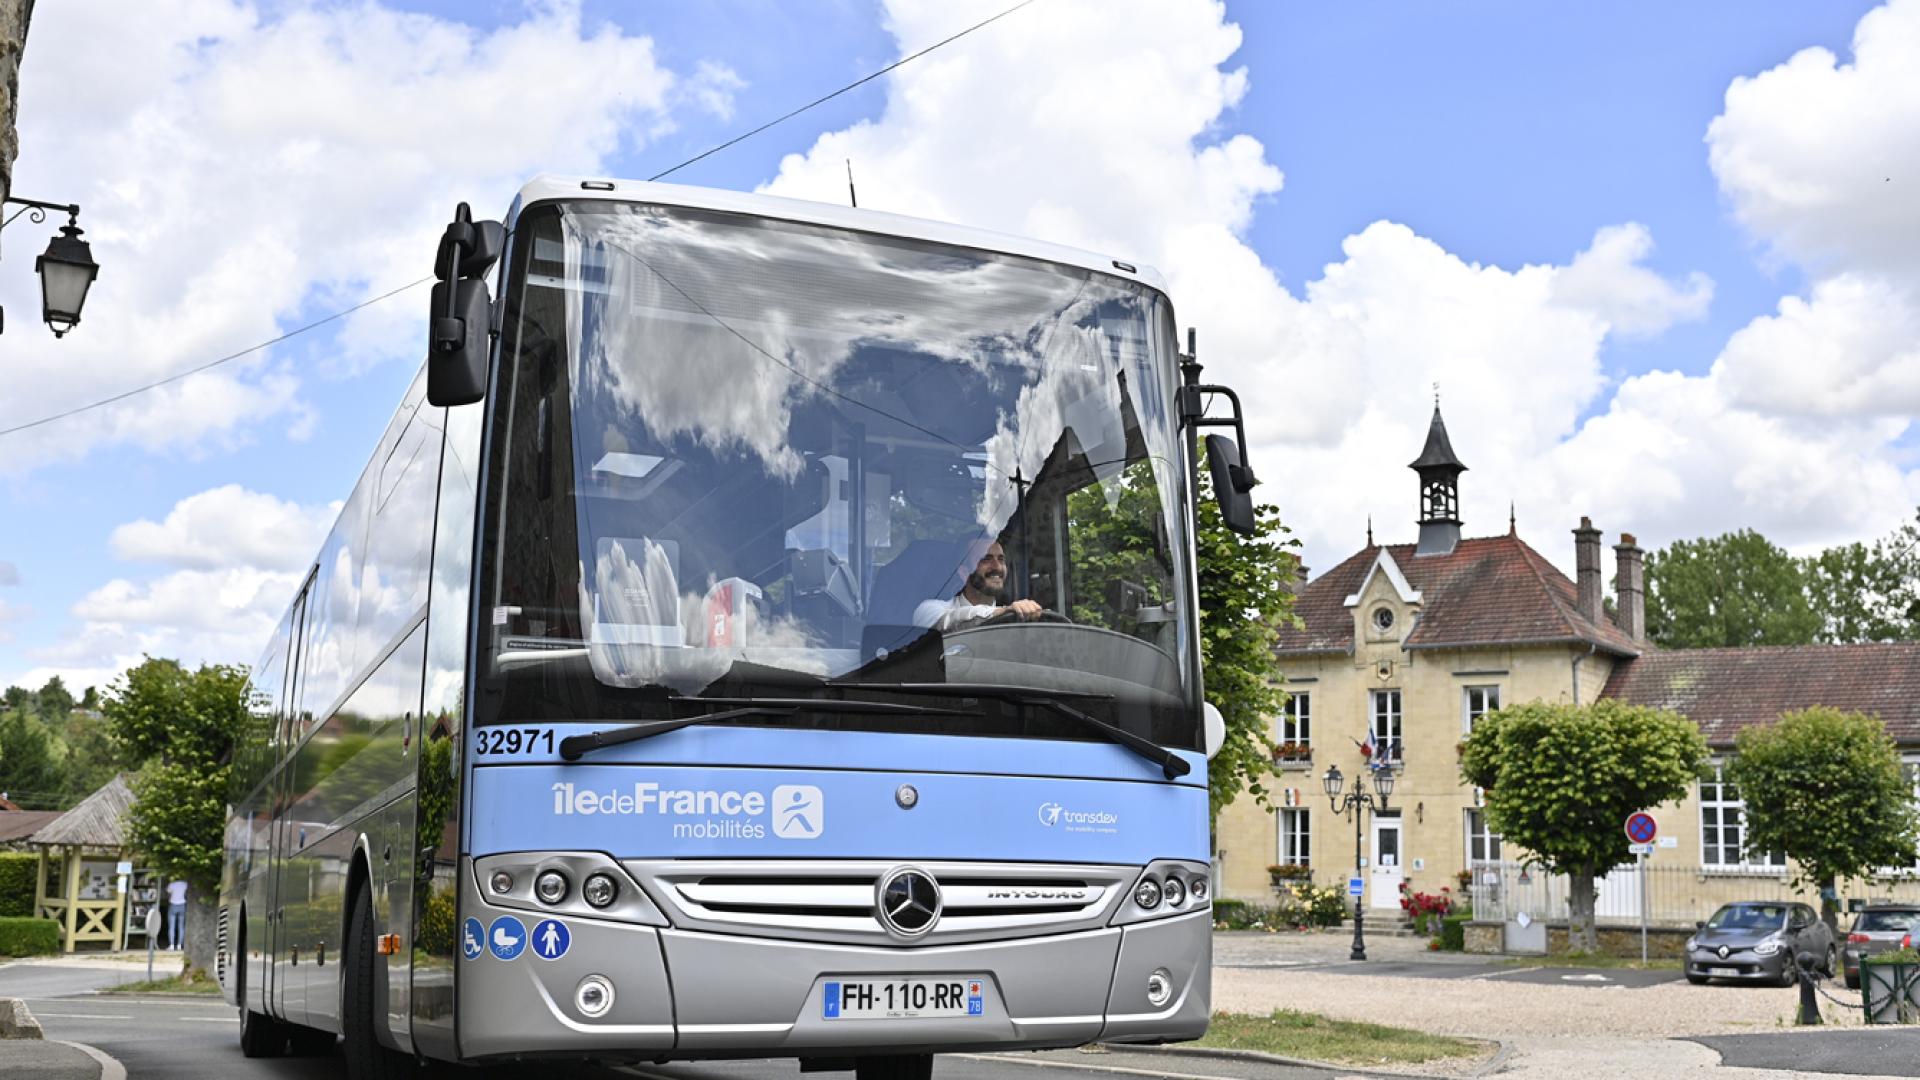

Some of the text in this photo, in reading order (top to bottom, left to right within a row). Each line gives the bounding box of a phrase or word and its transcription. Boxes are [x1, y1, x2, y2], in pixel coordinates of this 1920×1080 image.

[476, 729, 554, 754] 32971
[1064, 809, 1118, 824] transdev
[673, 819, 765, 838] mobilités
[842, 983, 964, 1010] FH-110-RR
[969, 1000, 981, 1012] 78
